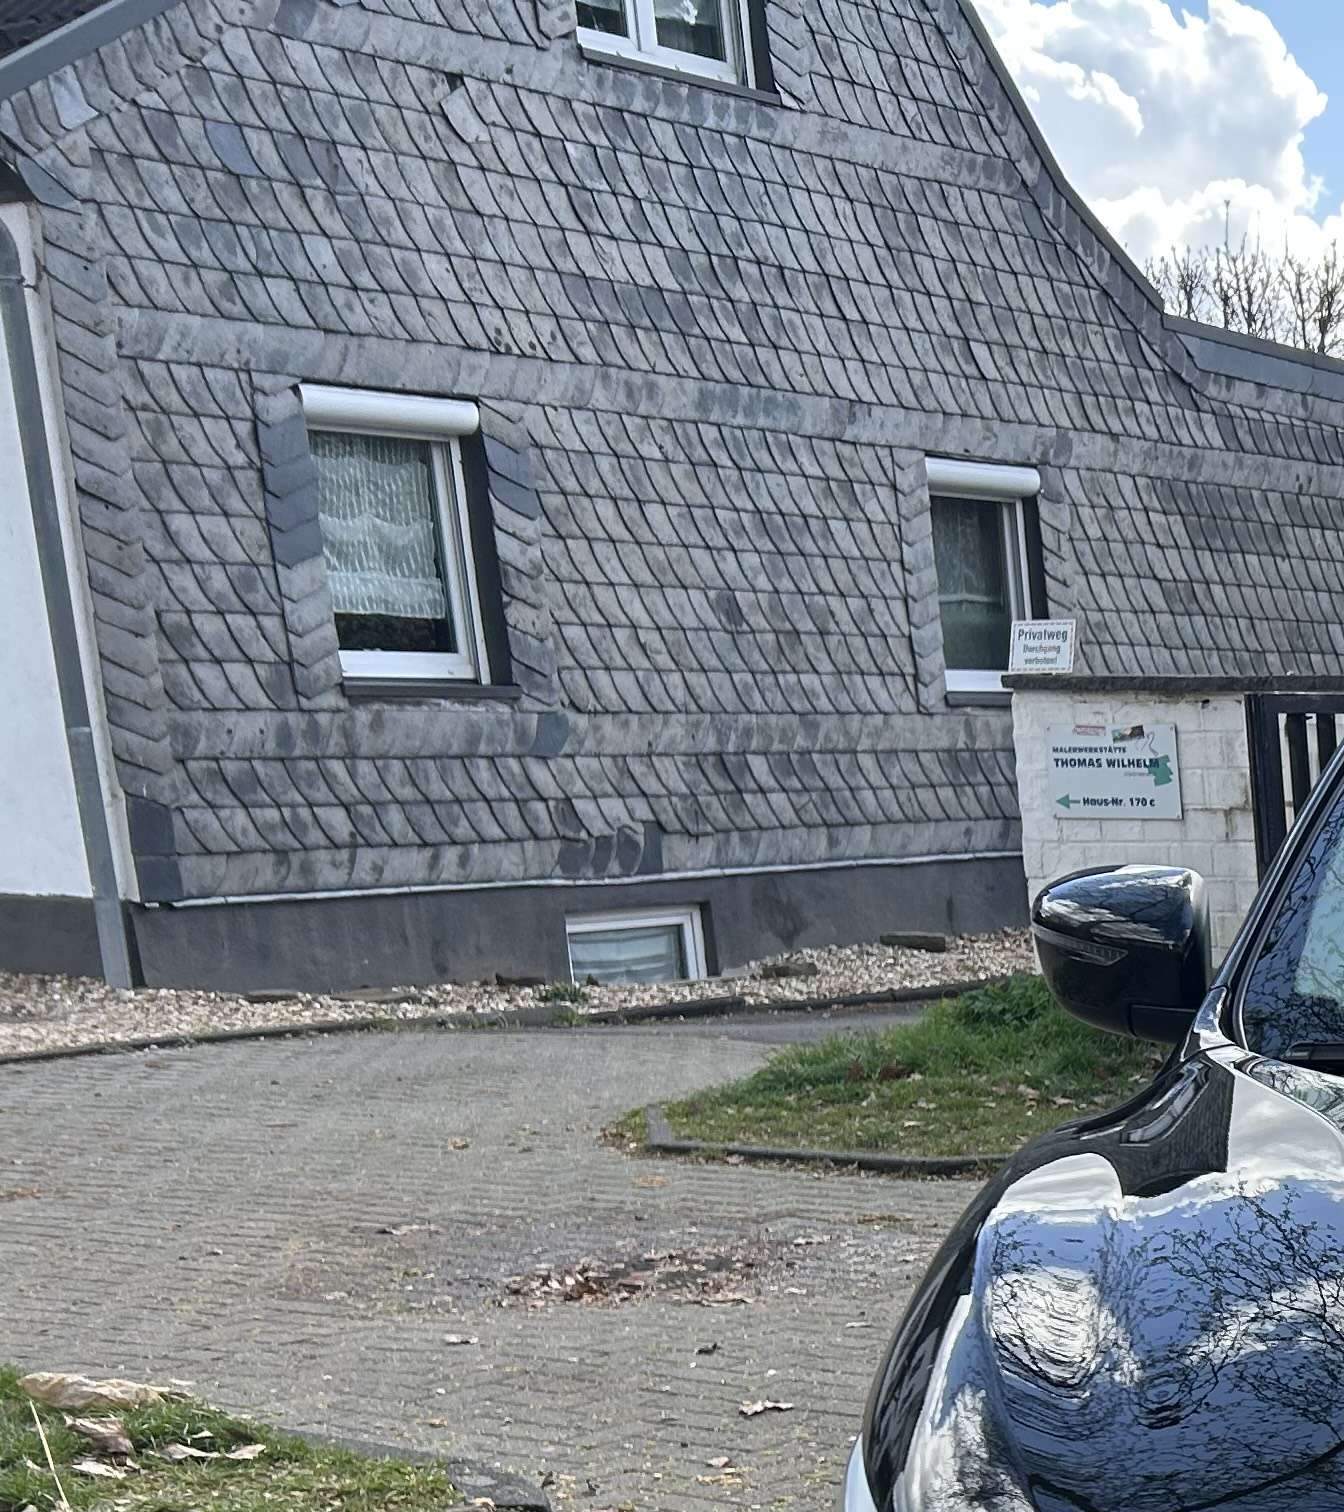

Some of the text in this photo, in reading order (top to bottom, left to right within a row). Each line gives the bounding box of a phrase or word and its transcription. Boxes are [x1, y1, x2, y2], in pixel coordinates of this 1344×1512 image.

[1017, 628, 1068, 643] Privatweg
[1053, 758, 1160, 768] THOMAS WILHELM
[1129, 797, 1148, 807] 170
